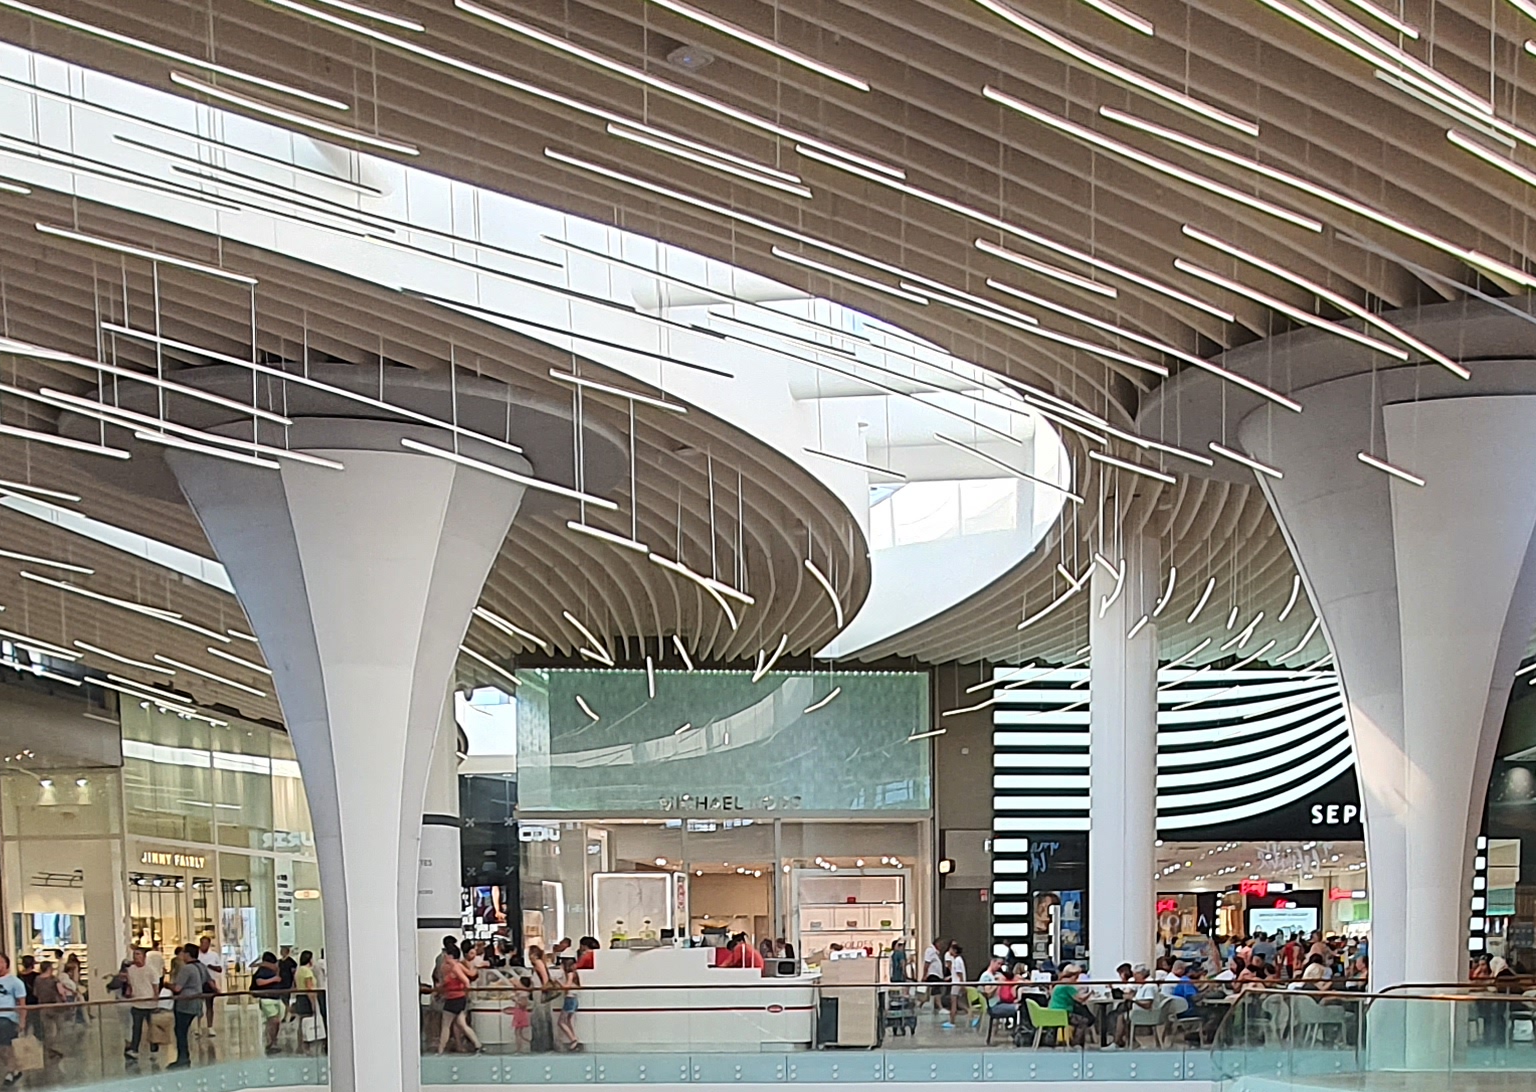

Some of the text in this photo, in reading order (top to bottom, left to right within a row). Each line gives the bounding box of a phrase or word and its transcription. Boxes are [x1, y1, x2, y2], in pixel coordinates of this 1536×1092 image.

[1311, 804, 1364, 824] SEP
[141, 851, 205, 869] JIMMY FAIRLY
